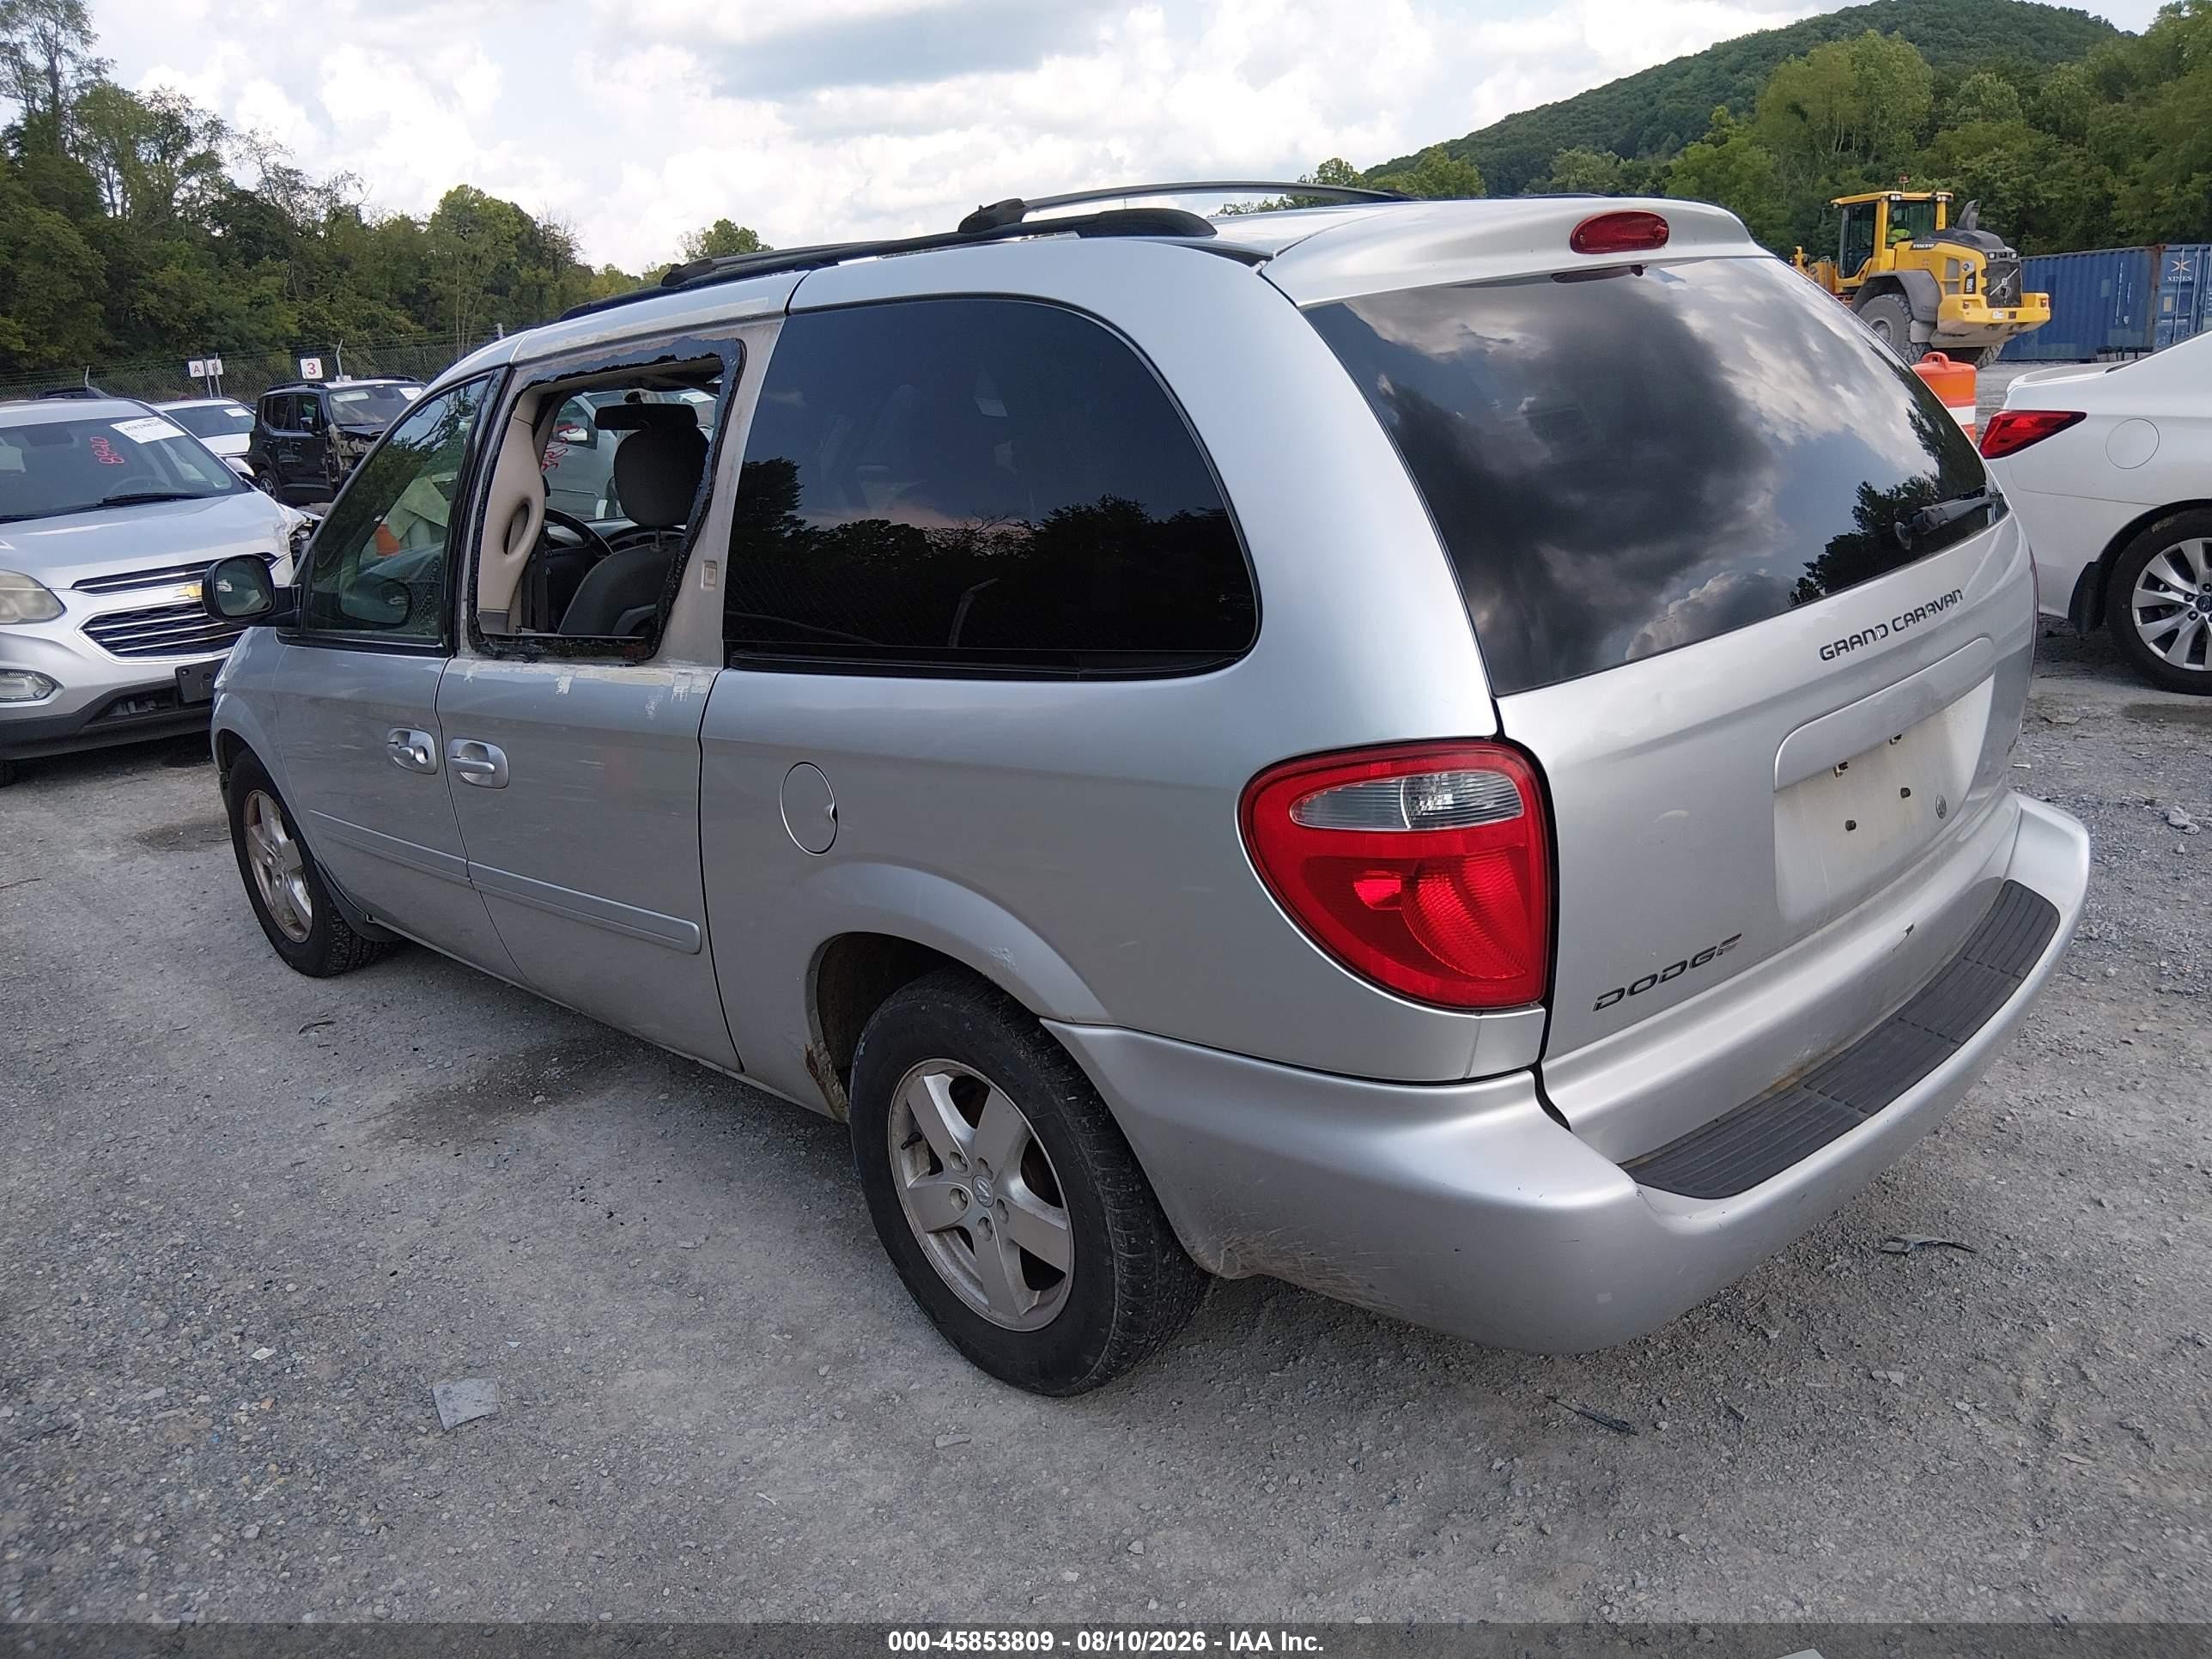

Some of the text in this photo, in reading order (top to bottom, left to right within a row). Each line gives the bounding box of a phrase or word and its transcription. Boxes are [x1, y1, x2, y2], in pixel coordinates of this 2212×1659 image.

[193, 363, 202, 374] A
[307, 362, 317, 374] 3
[1819, 589, 1964, 661] GRAND CARAVAN
